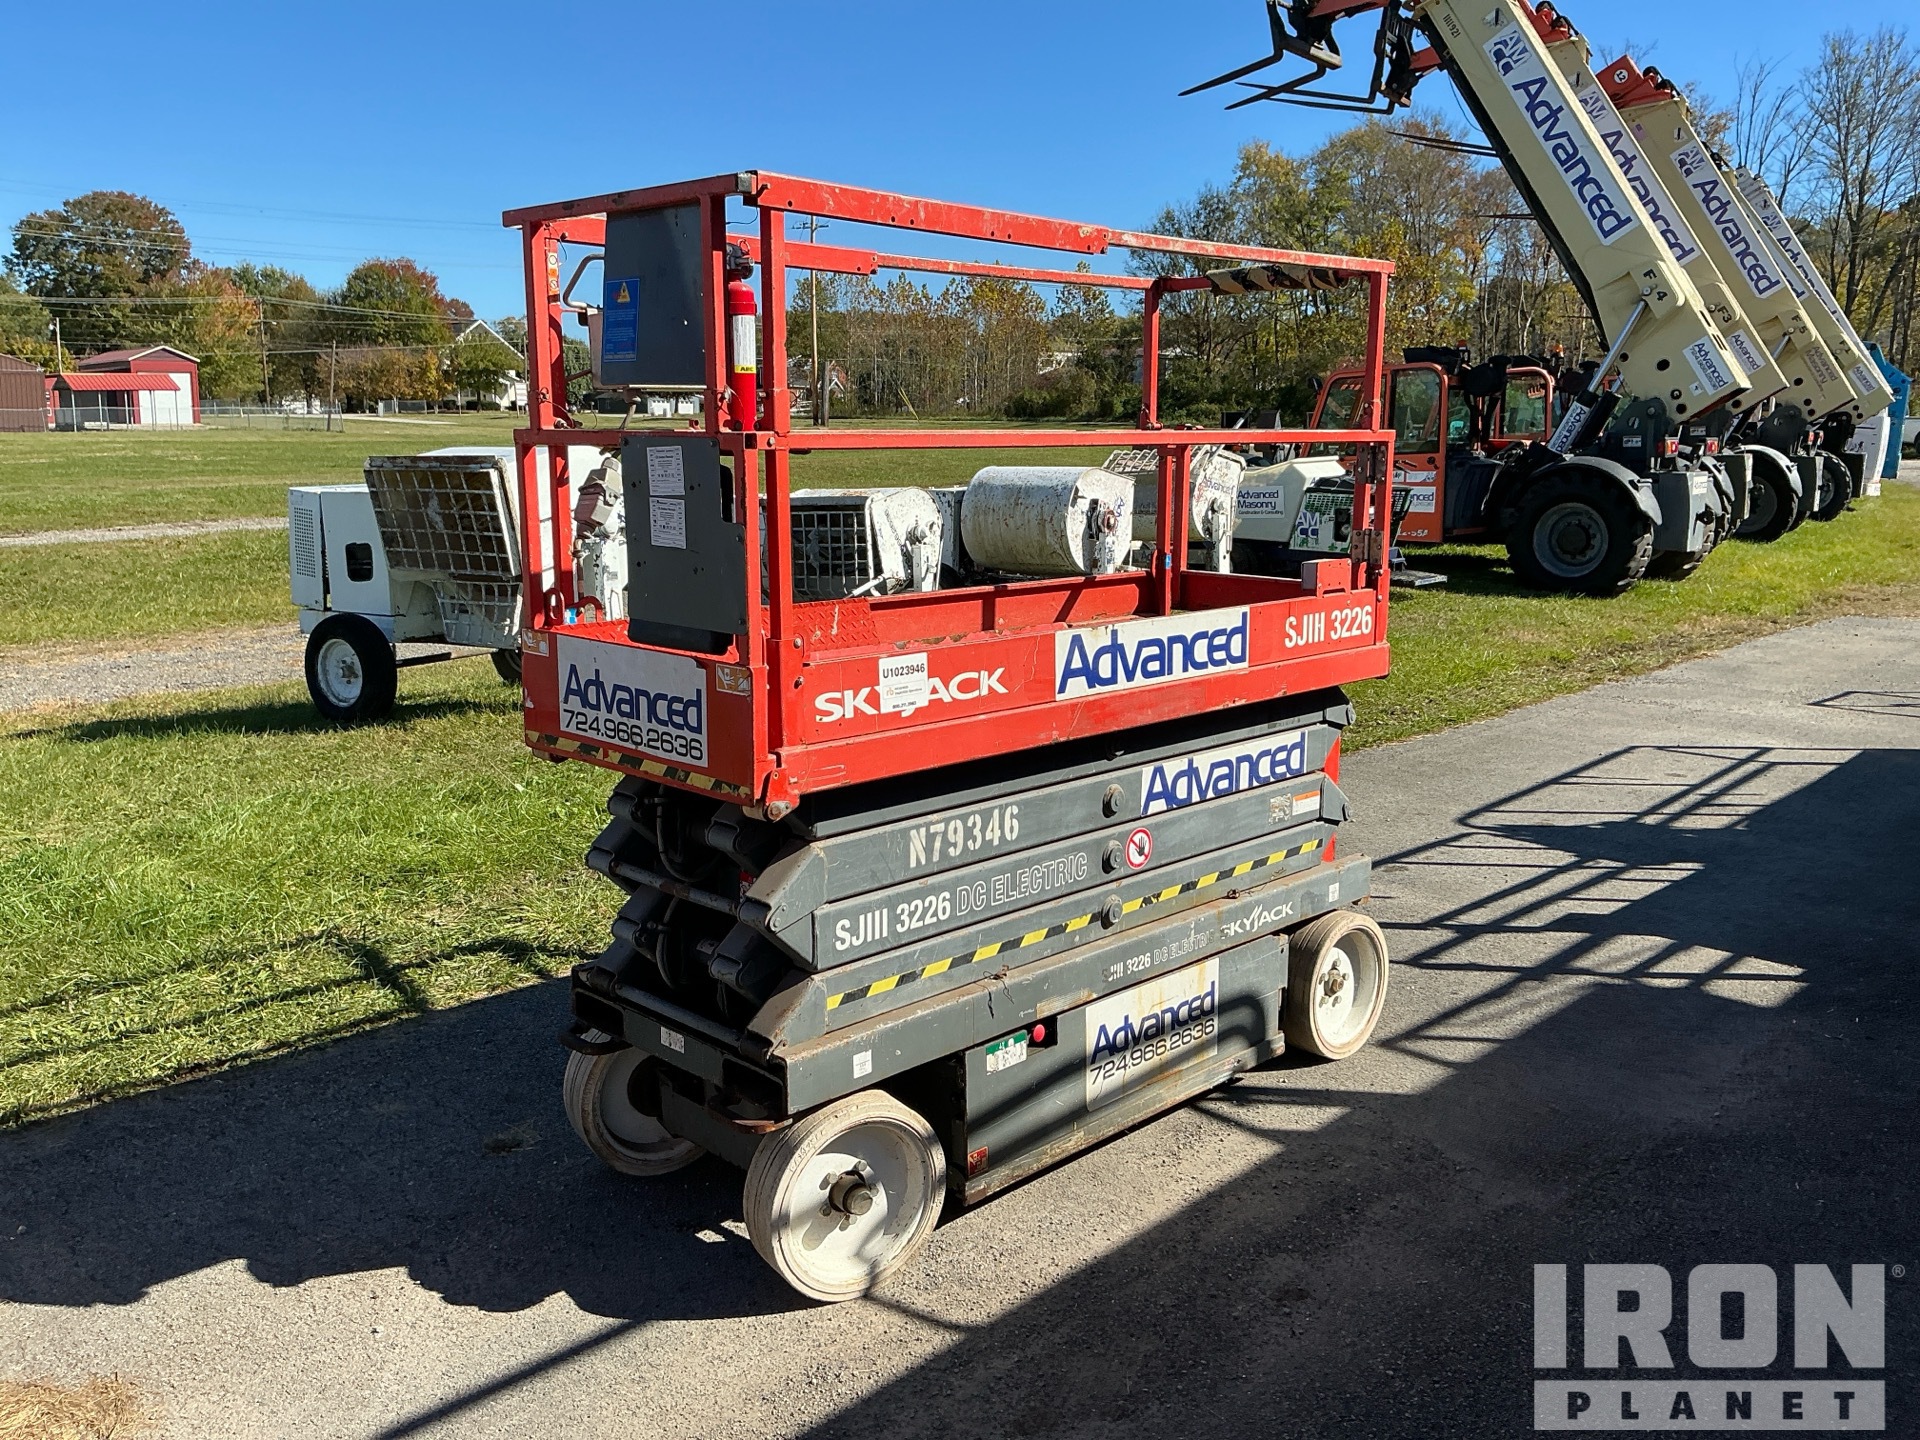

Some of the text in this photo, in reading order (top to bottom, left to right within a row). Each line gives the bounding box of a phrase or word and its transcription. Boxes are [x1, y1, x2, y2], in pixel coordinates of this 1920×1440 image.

[1512, 76, 1633, 239] Advanced
[1692, 179, 1782, 295] Advanced
[1643, 268, 1668, 301] F 4
[1717, 305, 1732, 323] F3
[1694, 343, 1729, 388] Advanced
[1731, 334, 1761, 370] Advanced
[1812, 346, 1838, 382] Advanced
[1555, 407, 1587, 452] Advanced
[1237, 490, 1279, 499] Advanced
[1237, 500, 1276, 510] Masonry
[1330, 605, 1373, 640] 3226
[882, 663, 926, 679] U1023946
[1057, 611, 1249, 694] Advanced
[563, 664, 703, 735] Advanced
[563, 708, 704, 761] 724.966.2636
[1141, 731, 1306, 817] Advanced
[909, 805, 1020, 868] N79346
[834, 852, 1088, 951] SJIII 3226 DC ELECTRIC
[1126, 953, 1151, 974] 3226
[1153, 948, 1168, 965] DC
[1090, 981, 1216, 1065] Advanced
[1090, 1018, 1216, 1086] 724.966.2636
